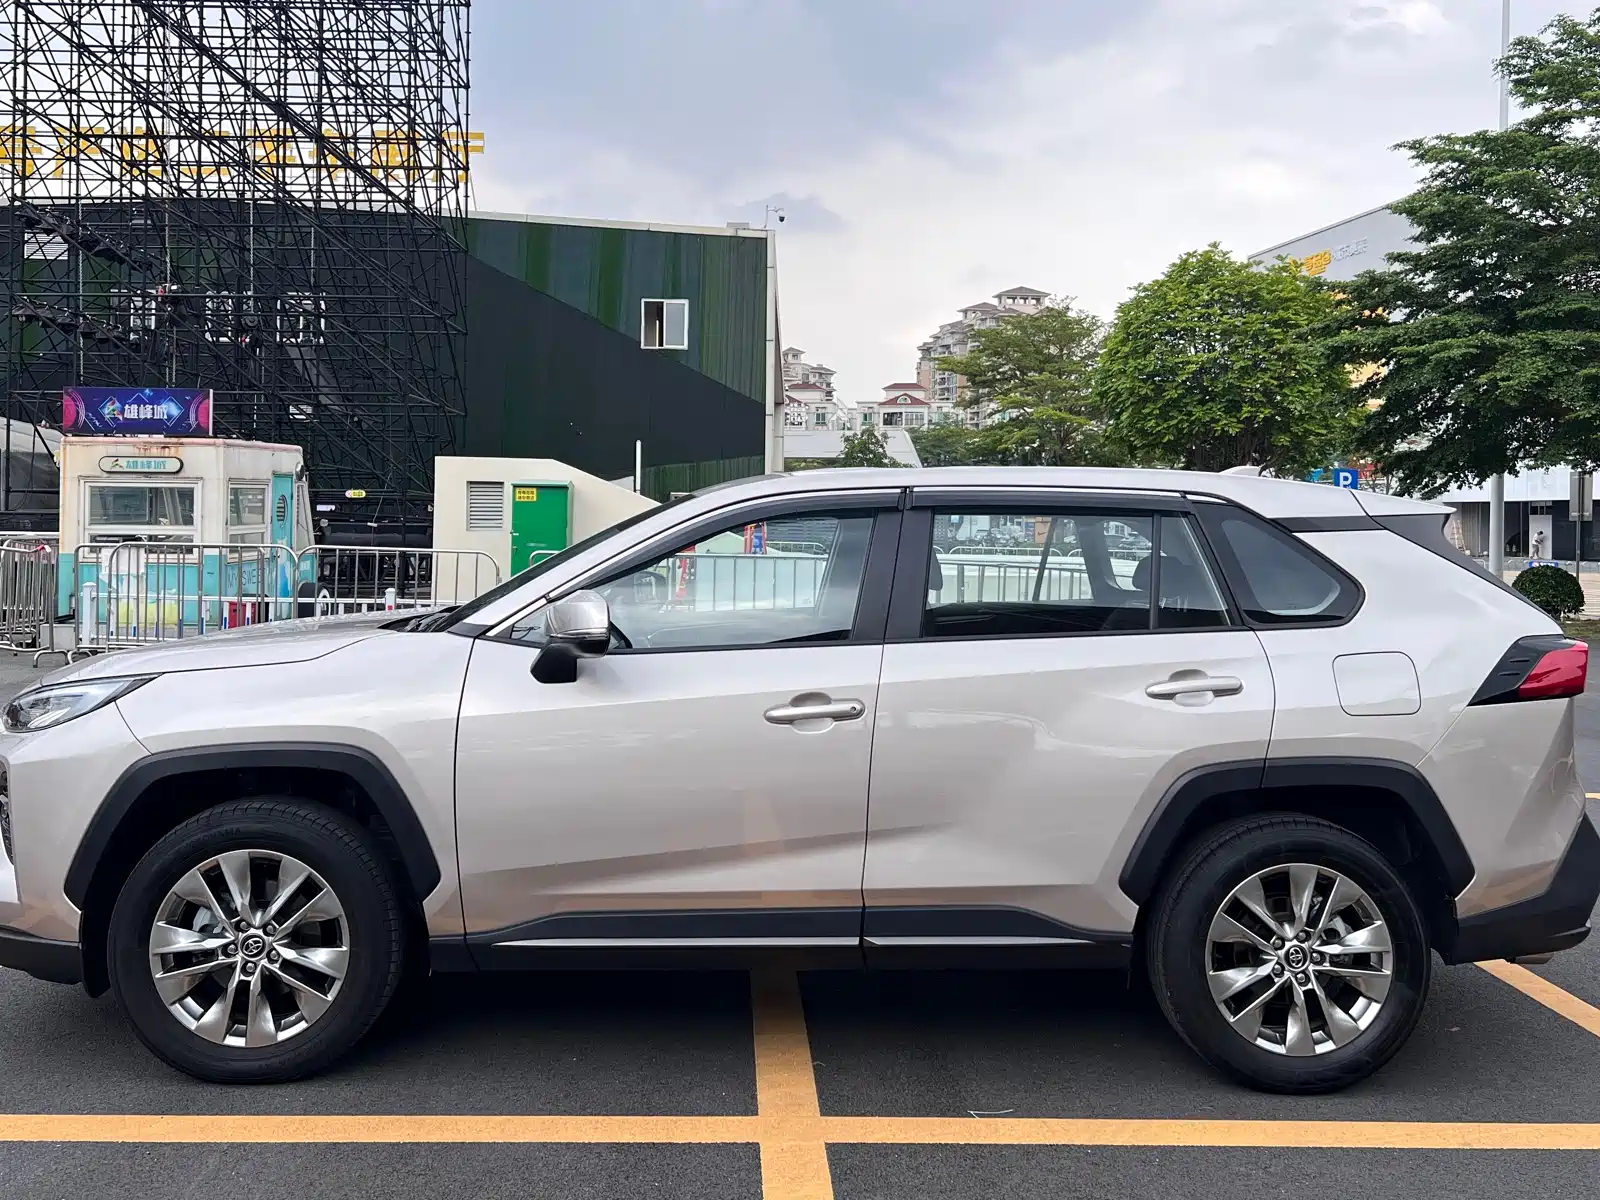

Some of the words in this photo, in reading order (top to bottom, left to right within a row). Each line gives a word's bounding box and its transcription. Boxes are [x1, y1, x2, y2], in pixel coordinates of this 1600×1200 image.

[124, 404, 168, 420] 雄峰城
[125, 460, 167, 470] 雄峰城
[1339, 472, 1353, 488] P
